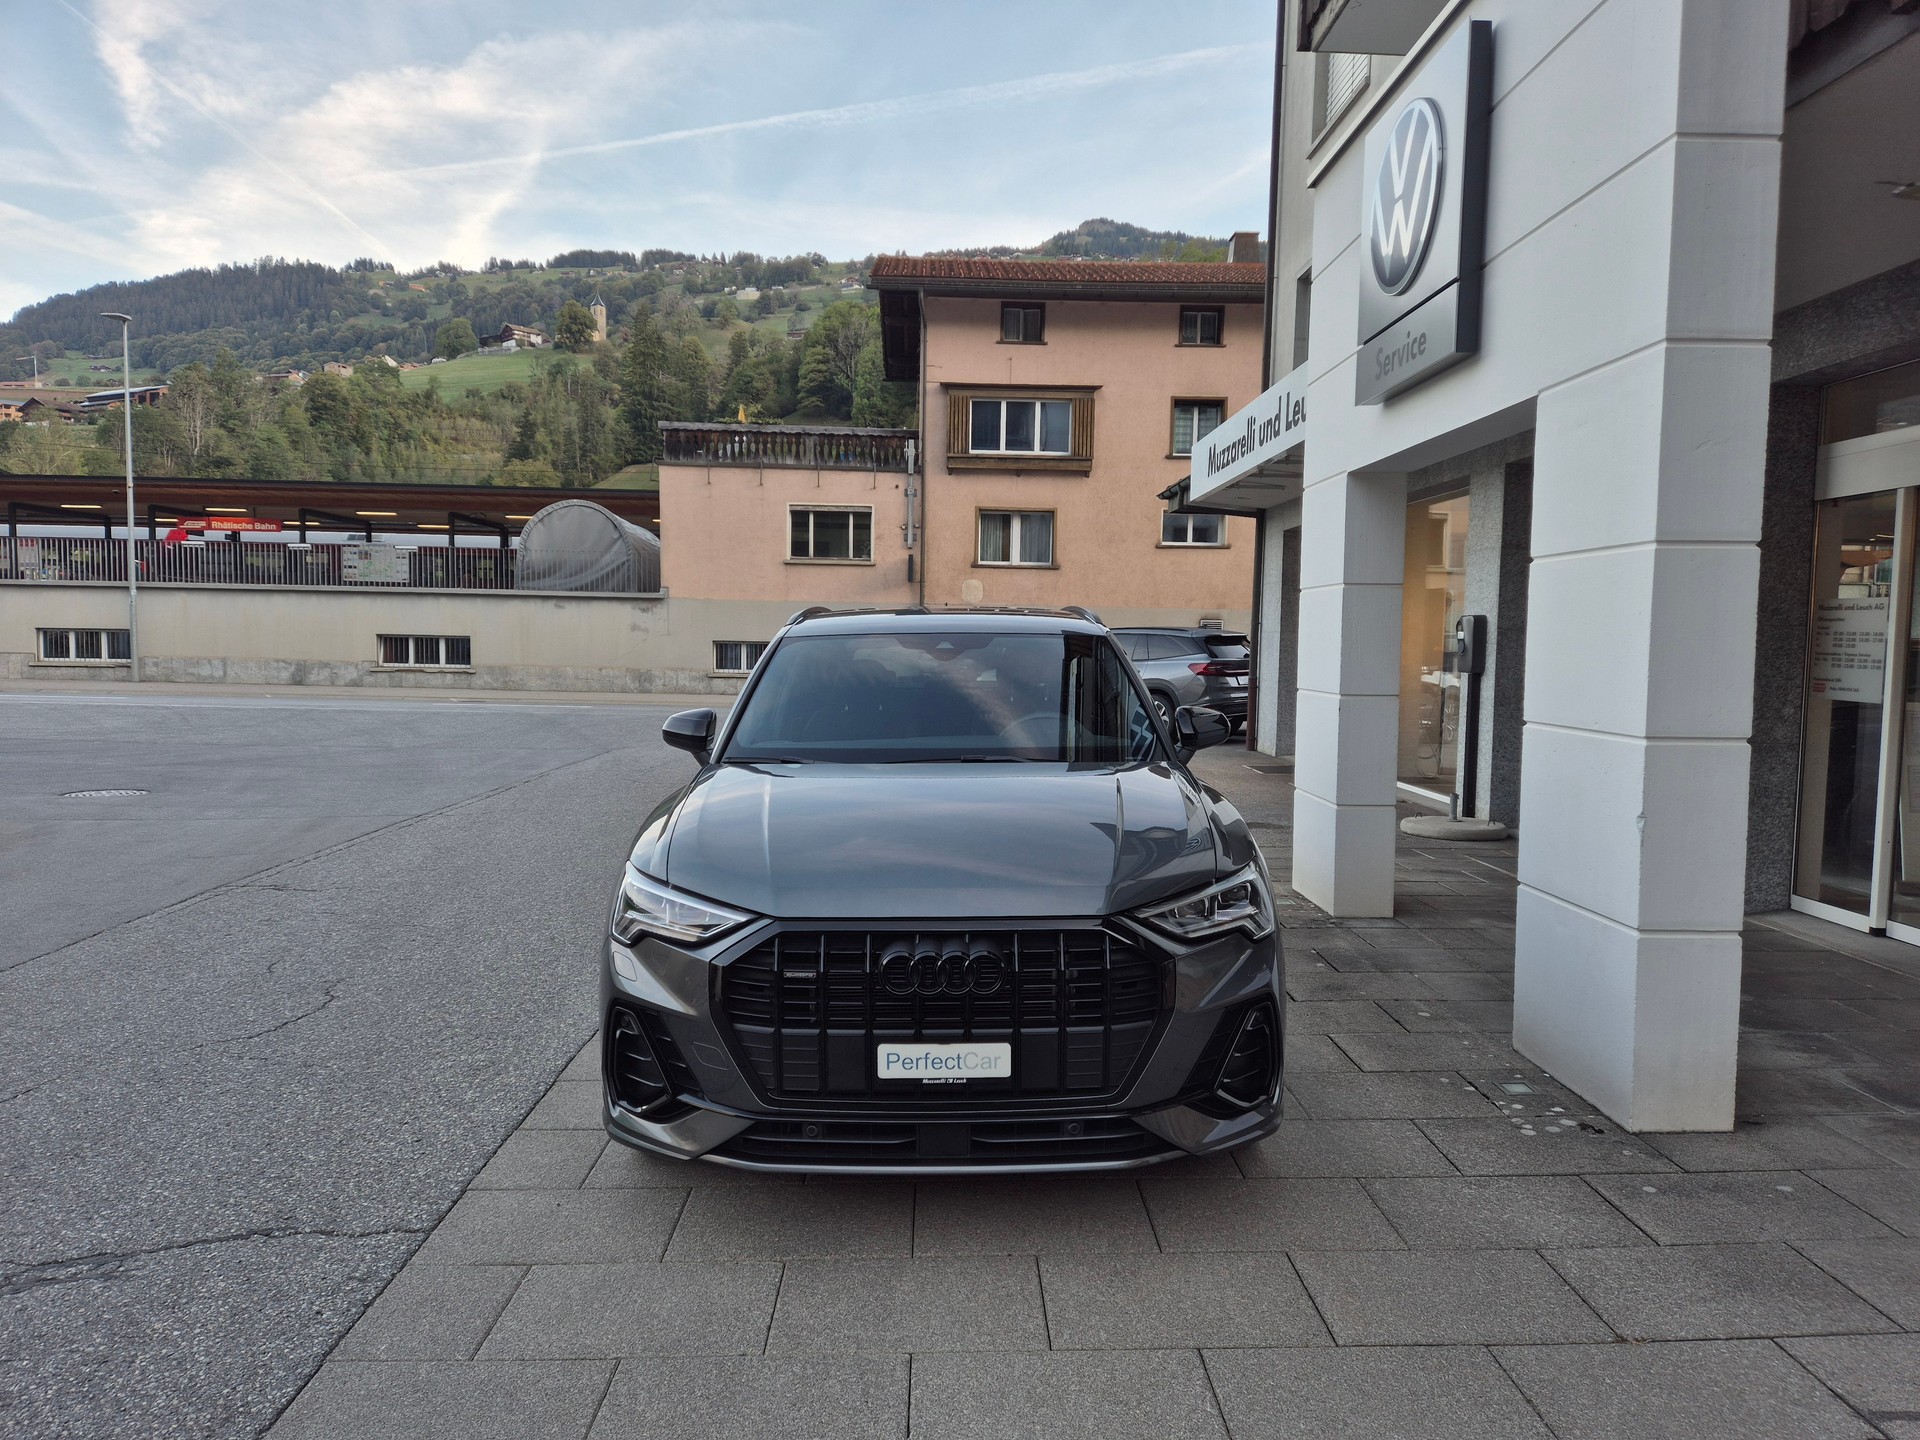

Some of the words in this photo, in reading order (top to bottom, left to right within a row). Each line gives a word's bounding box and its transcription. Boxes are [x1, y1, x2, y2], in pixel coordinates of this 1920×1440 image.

[1375, 329, 1427, 381] Service
[1207, 415, 1256, 478] Muzzarelli
[1258, 395, 1282, 448] und
[211, 521, 253, 530] Rhätische
[254, 522, 276, 531] Bahn
[1874, 603, 1885, 611] AG
[886, 1051, 1002, 1071] PerfectCar
